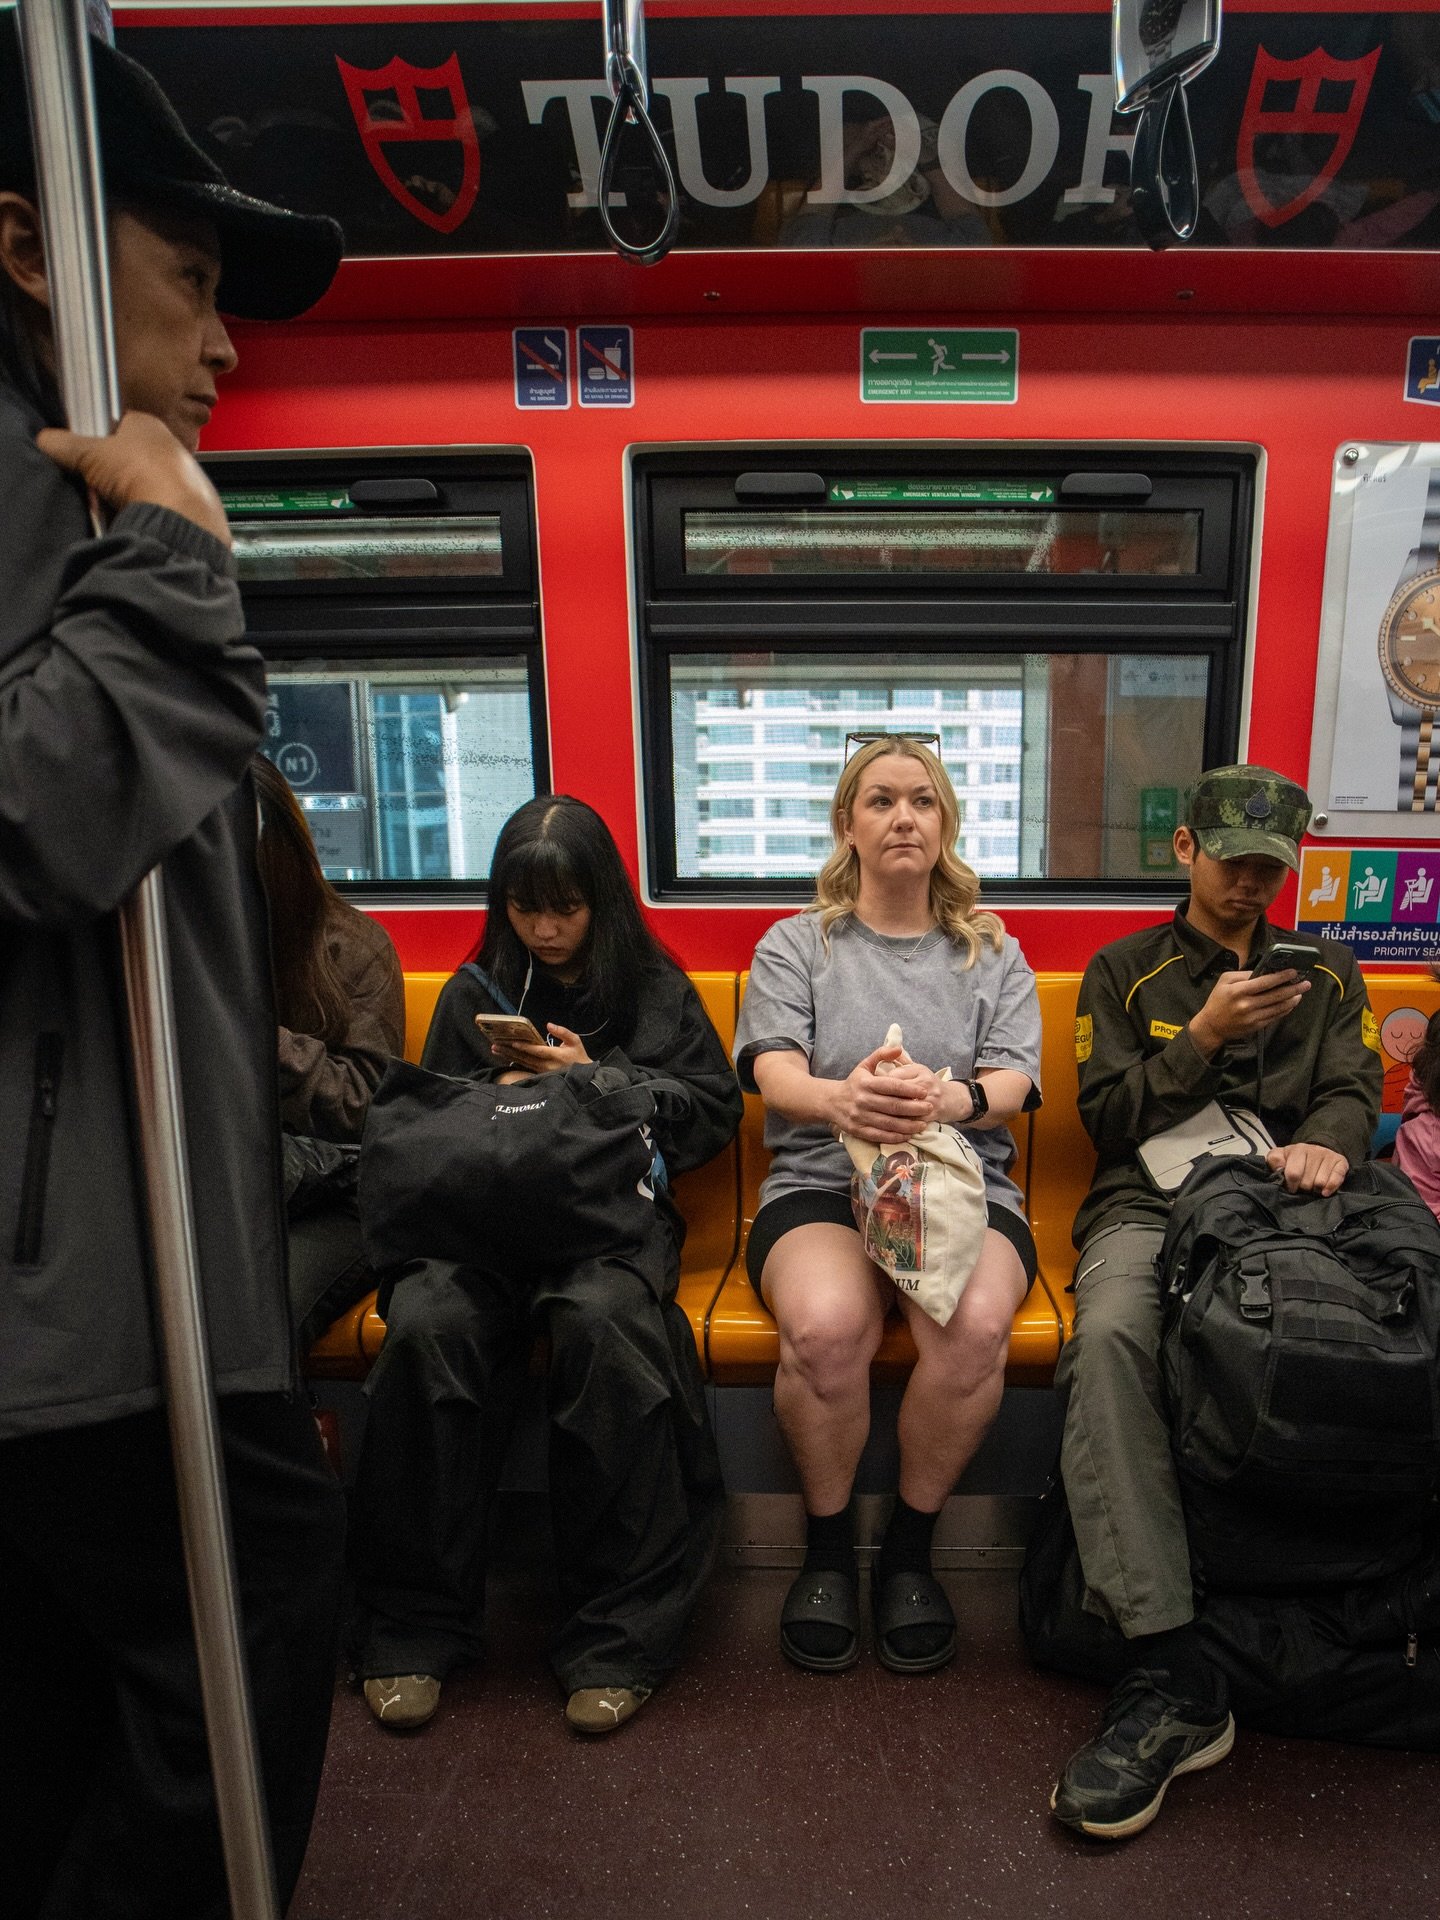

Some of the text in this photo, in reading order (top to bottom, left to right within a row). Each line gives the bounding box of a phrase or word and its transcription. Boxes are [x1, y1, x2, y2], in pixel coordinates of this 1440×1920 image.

[1321, 923, 1440, 946] ที่นั่งสำรองสำหรับบุ
[1374, 946, 1440, 957] PRIORITY SEA
[1154, 1025, 1179, 1036] PROS
[896, 1278, 920, 1291] UM
